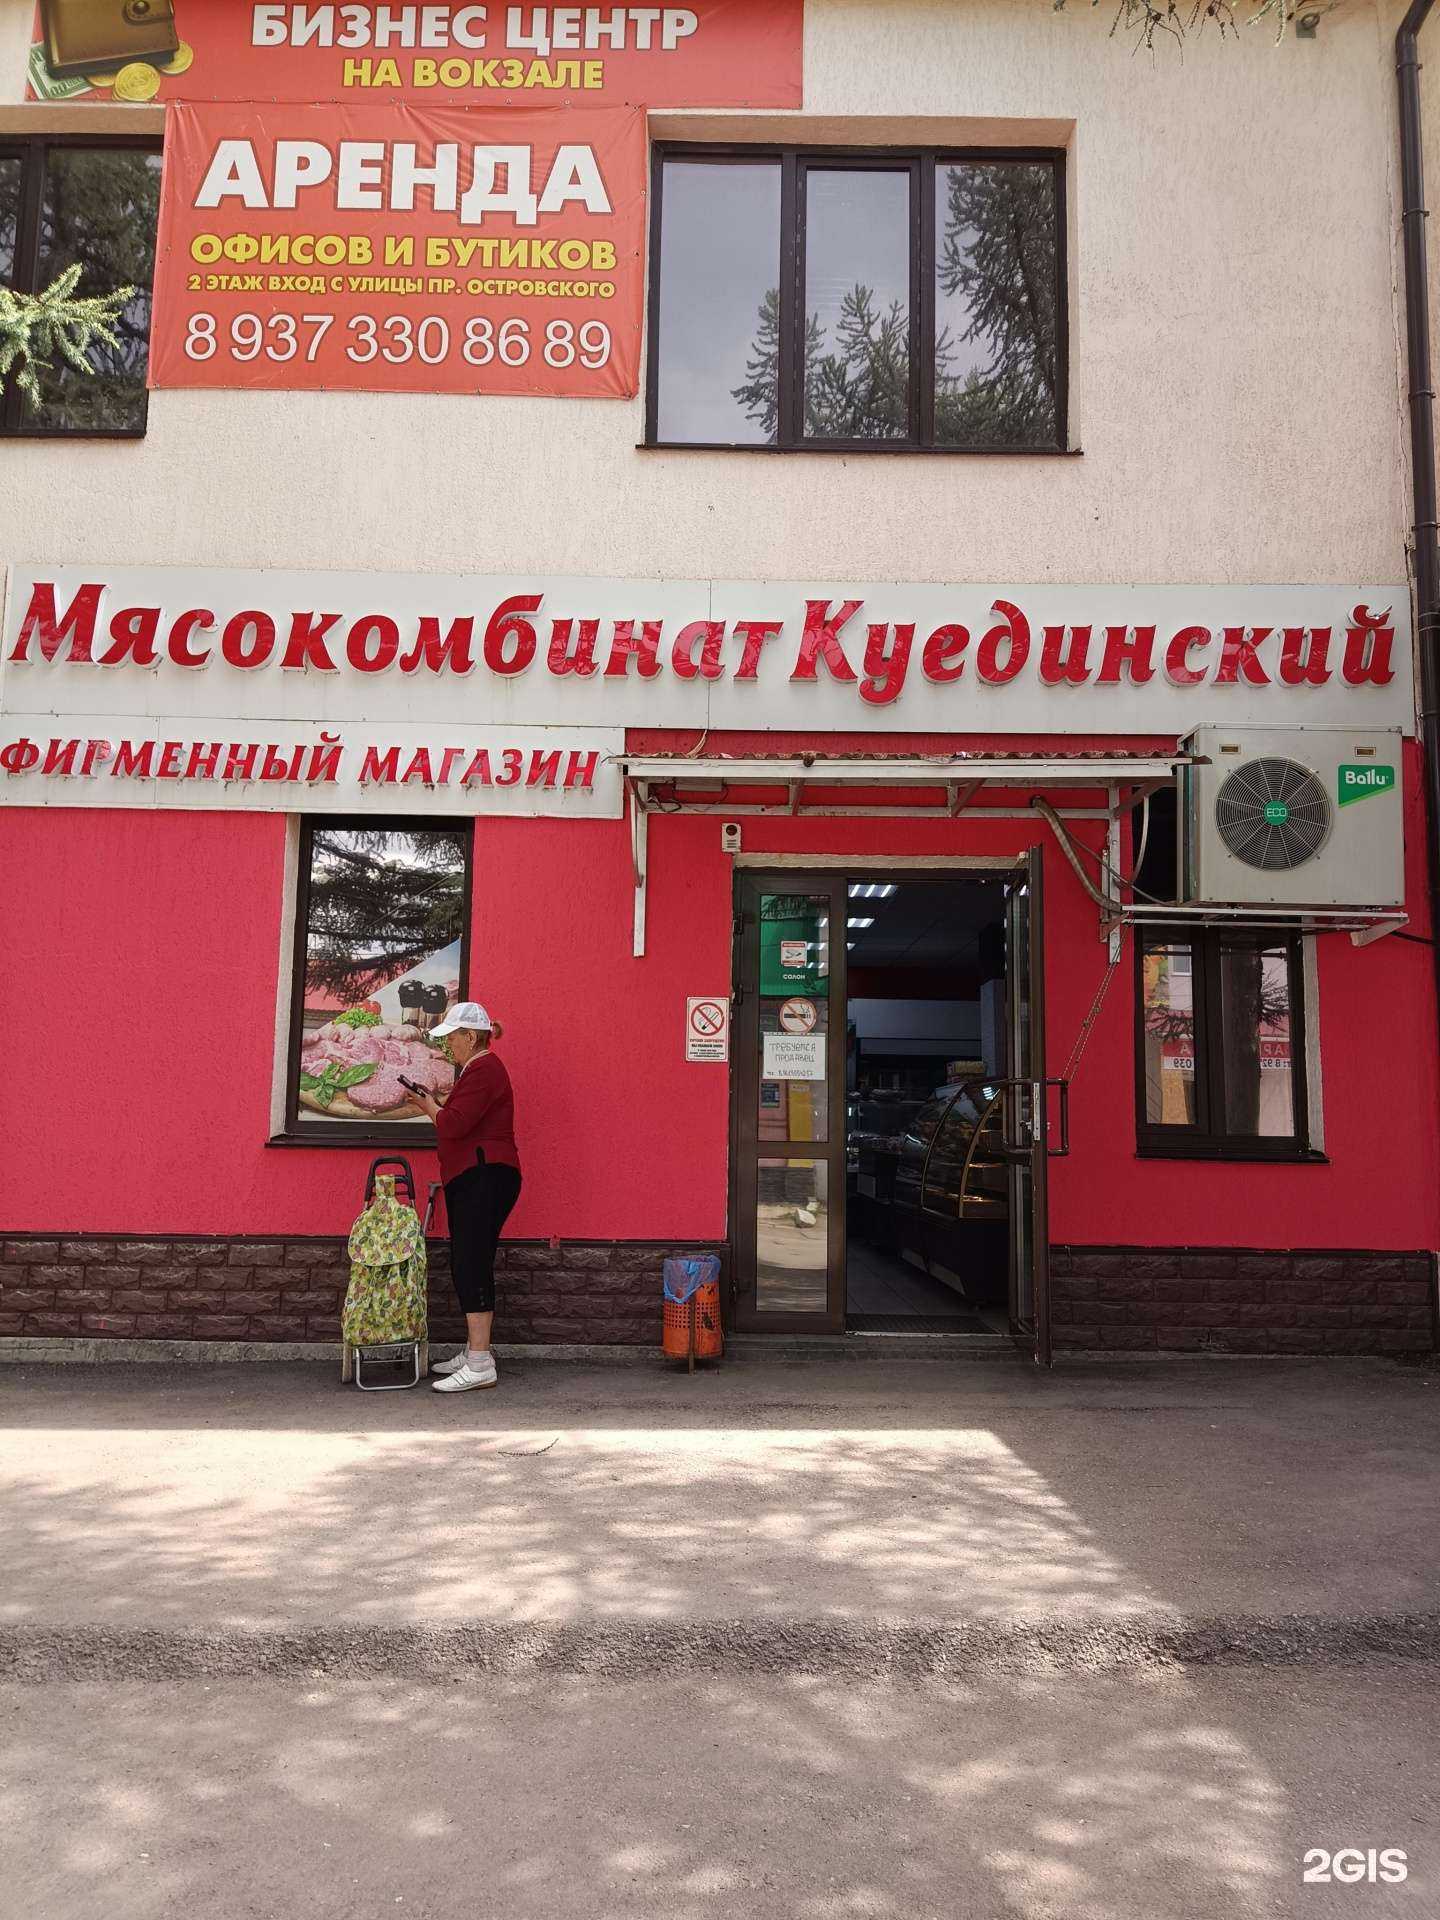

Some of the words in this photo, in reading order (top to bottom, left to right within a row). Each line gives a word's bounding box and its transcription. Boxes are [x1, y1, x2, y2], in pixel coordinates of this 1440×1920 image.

[251, 4, 487, 48] БИЗНЕС
[505, 6, 699, 56] ЦЕНТР
[342, 58, 400, 87] НА
[411, 59, 604, 90] ВОКЗАЛЕ
[194, 139, 613, 226] АРЕНДА
[190, 233, 373, 265] ОФИСОВ
[384, 236, 414, 265] И
[426, 237, 617, 270] БУТИКОВ
[188, 275, 201, 290] 2
[206, 275, 264, 290] ЭТАЖ
[268, 276, 326, 293] ВХОД
[330, 277, 344, 291] С
[349, 277, 422, 295] УЛИЦЫ
[428, 278, 462, 294] ПР.
[467, 279, 615, 298] ОСТРОВСКОГО
[185, 313, 217, 360] 8
[231, 313, 334, 361] 937
[346, 315, 449, 364] 330
[463, 317, 530, 366] 86
[543, 320, 612, 369] 89
[8, 581, 784, 682] Мясокомбинат
[791, 599, 1397, 706] Куединский
[0, 732, 347, 784] ФИРМЕННЫЙ
[359, 746, 601, 790] МАГАЗИН
[1345, 770, 1385, 785] Ballu
[1266, 807, 1287, 817] ECO
